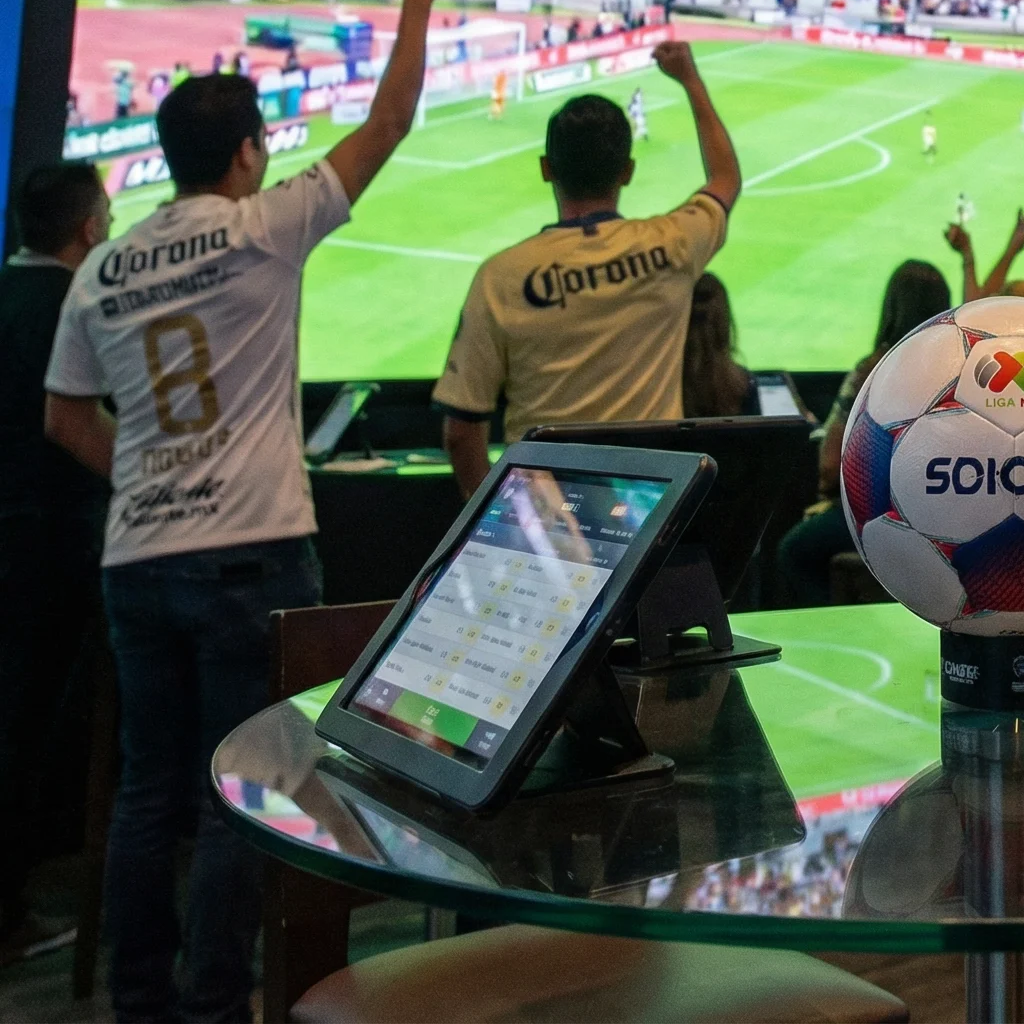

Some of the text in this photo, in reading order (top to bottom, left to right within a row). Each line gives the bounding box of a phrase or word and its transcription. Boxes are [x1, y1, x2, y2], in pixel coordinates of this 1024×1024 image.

[97, 227, 230, 287] Corona
[523, 245, 672, 310] Corona
[142, 313, 220, 436] 8
[985, 397, 1016, 409] LIGA
